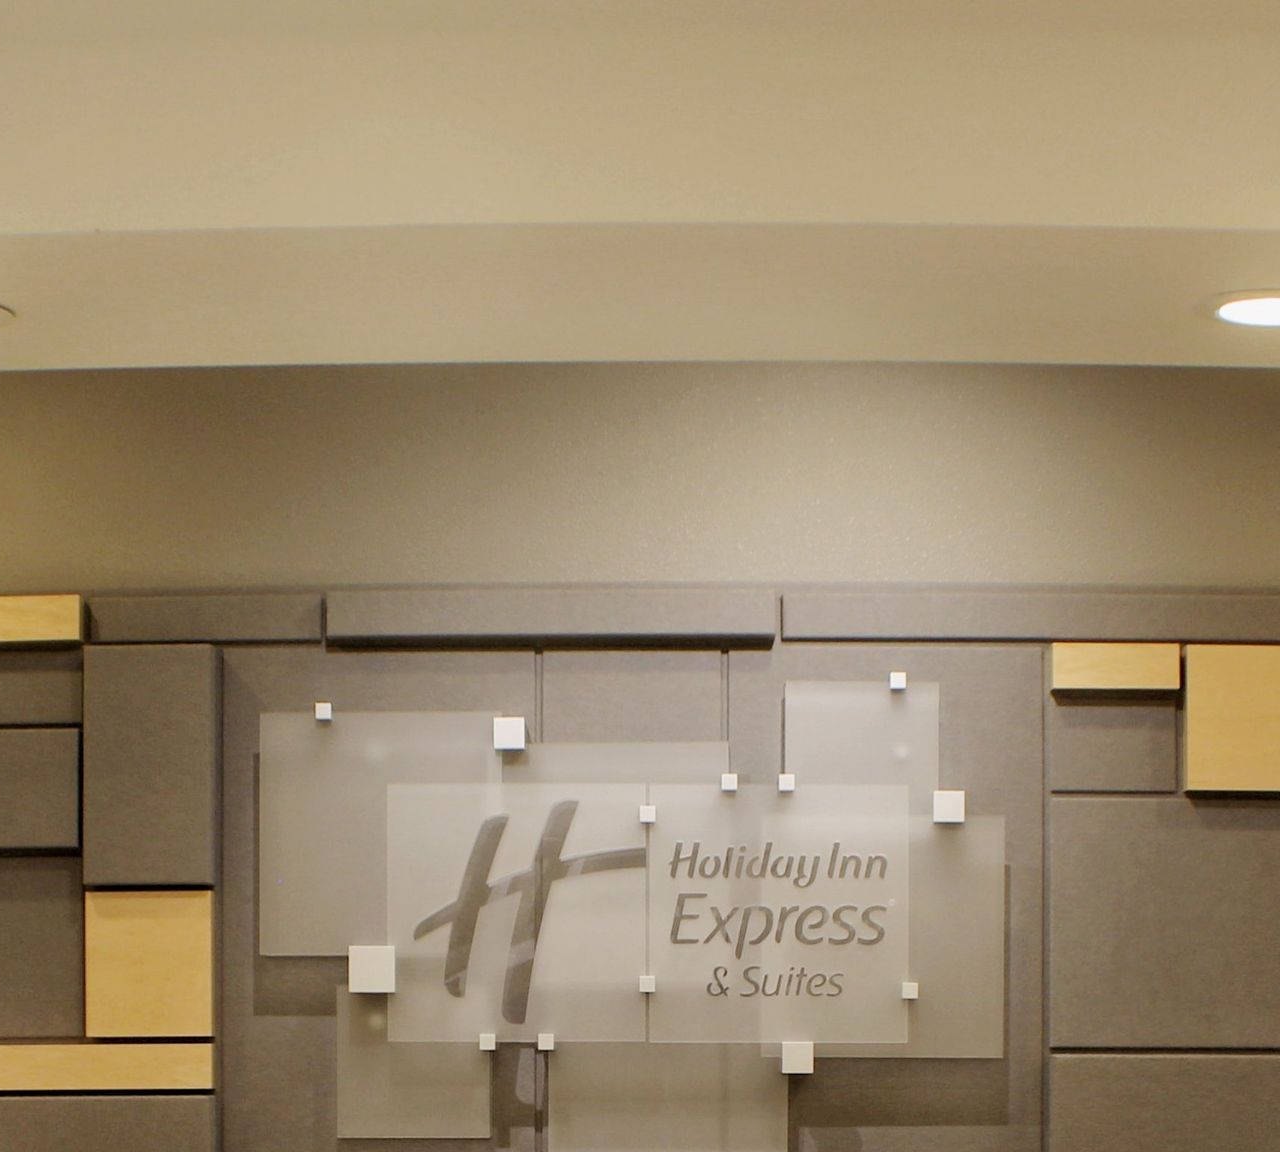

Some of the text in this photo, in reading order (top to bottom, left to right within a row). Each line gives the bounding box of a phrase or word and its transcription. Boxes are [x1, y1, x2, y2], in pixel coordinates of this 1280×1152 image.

[670, 842, 888, 888] Holiday Inn
[670, 893, 887, 960] Express
[706, 966, 844, 997] & Suites
